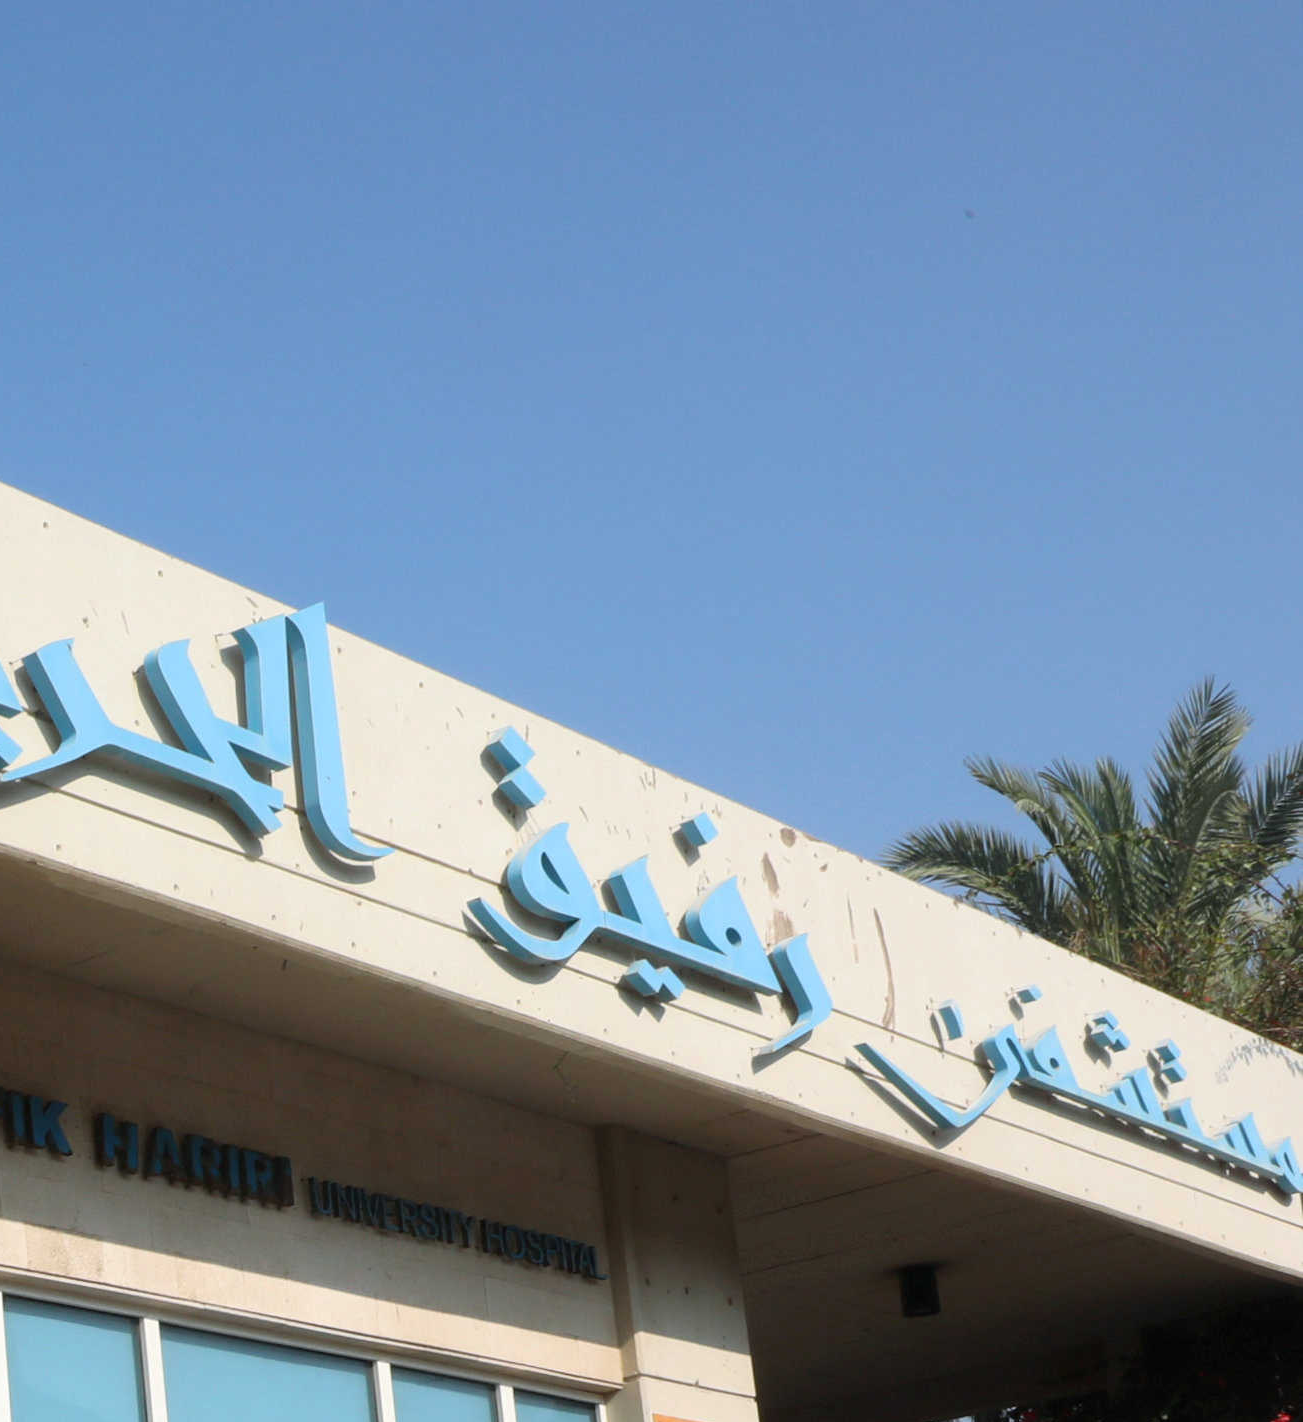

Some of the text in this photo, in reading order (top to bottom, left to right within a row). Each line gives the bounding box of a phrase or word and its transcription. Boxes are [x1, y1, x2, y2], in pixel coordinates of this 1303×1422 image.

[465, 724, 833, 1058] رفيق
[92, 1111, 295, 1208] HARIRI
[306, 1176, 476, 1249] UNIVERSITY
[479, 1218, 609, 1290] HOSPITAL
